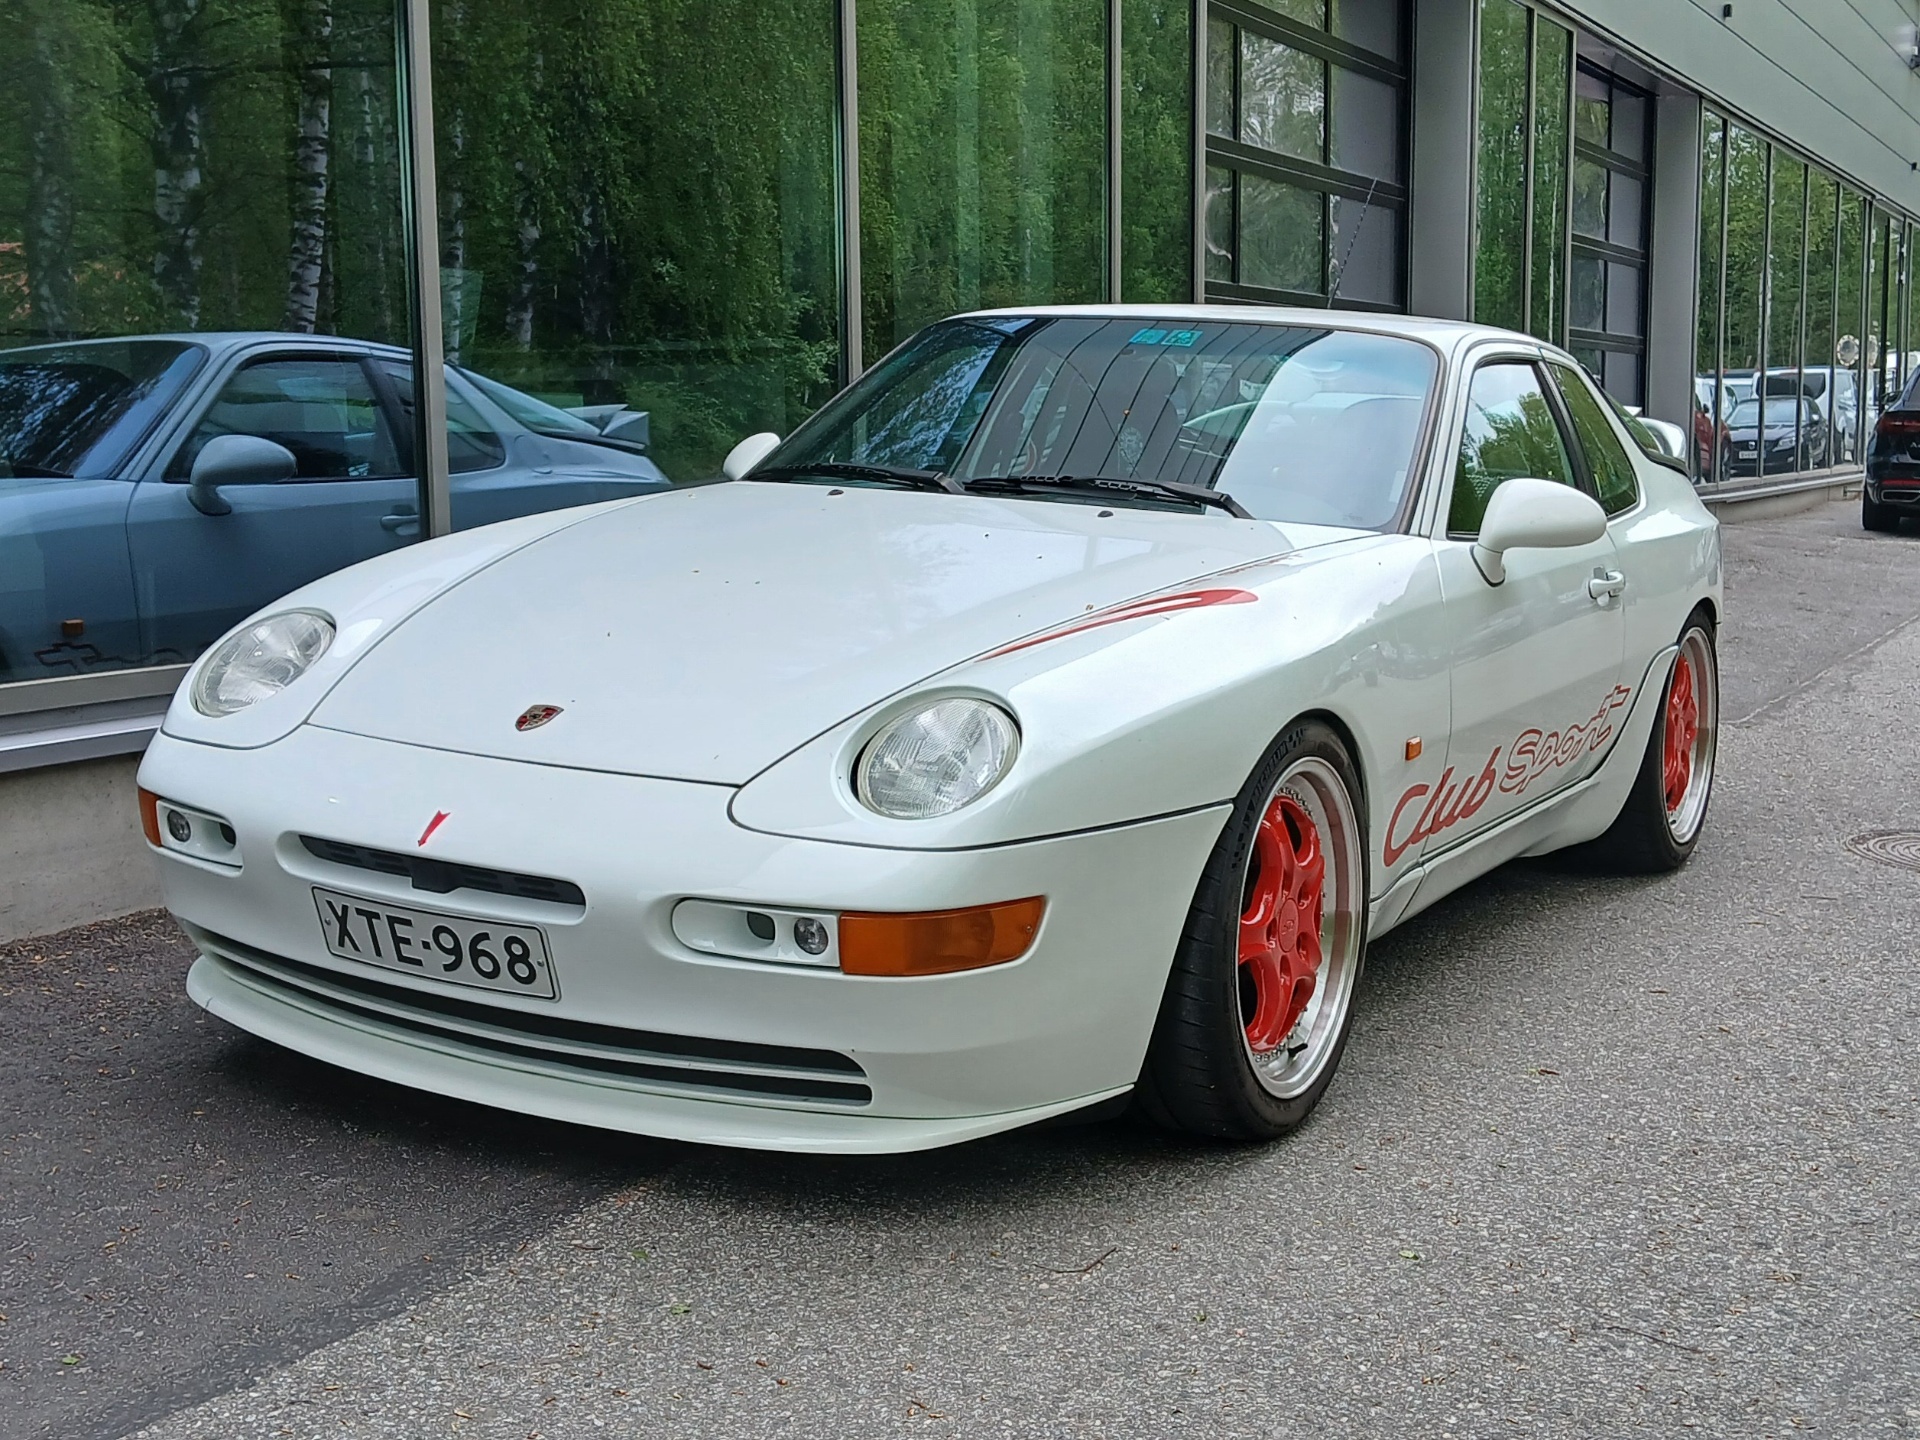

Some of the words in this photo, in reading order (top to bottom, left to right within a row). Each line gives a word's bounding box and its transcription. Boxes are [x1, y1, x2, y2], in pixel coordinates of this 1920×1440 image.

[1383, 746, 1502, 867] Club
[1499, 684, 1631, 795] Sport
[325, 899, 538, 985] XTE-968
